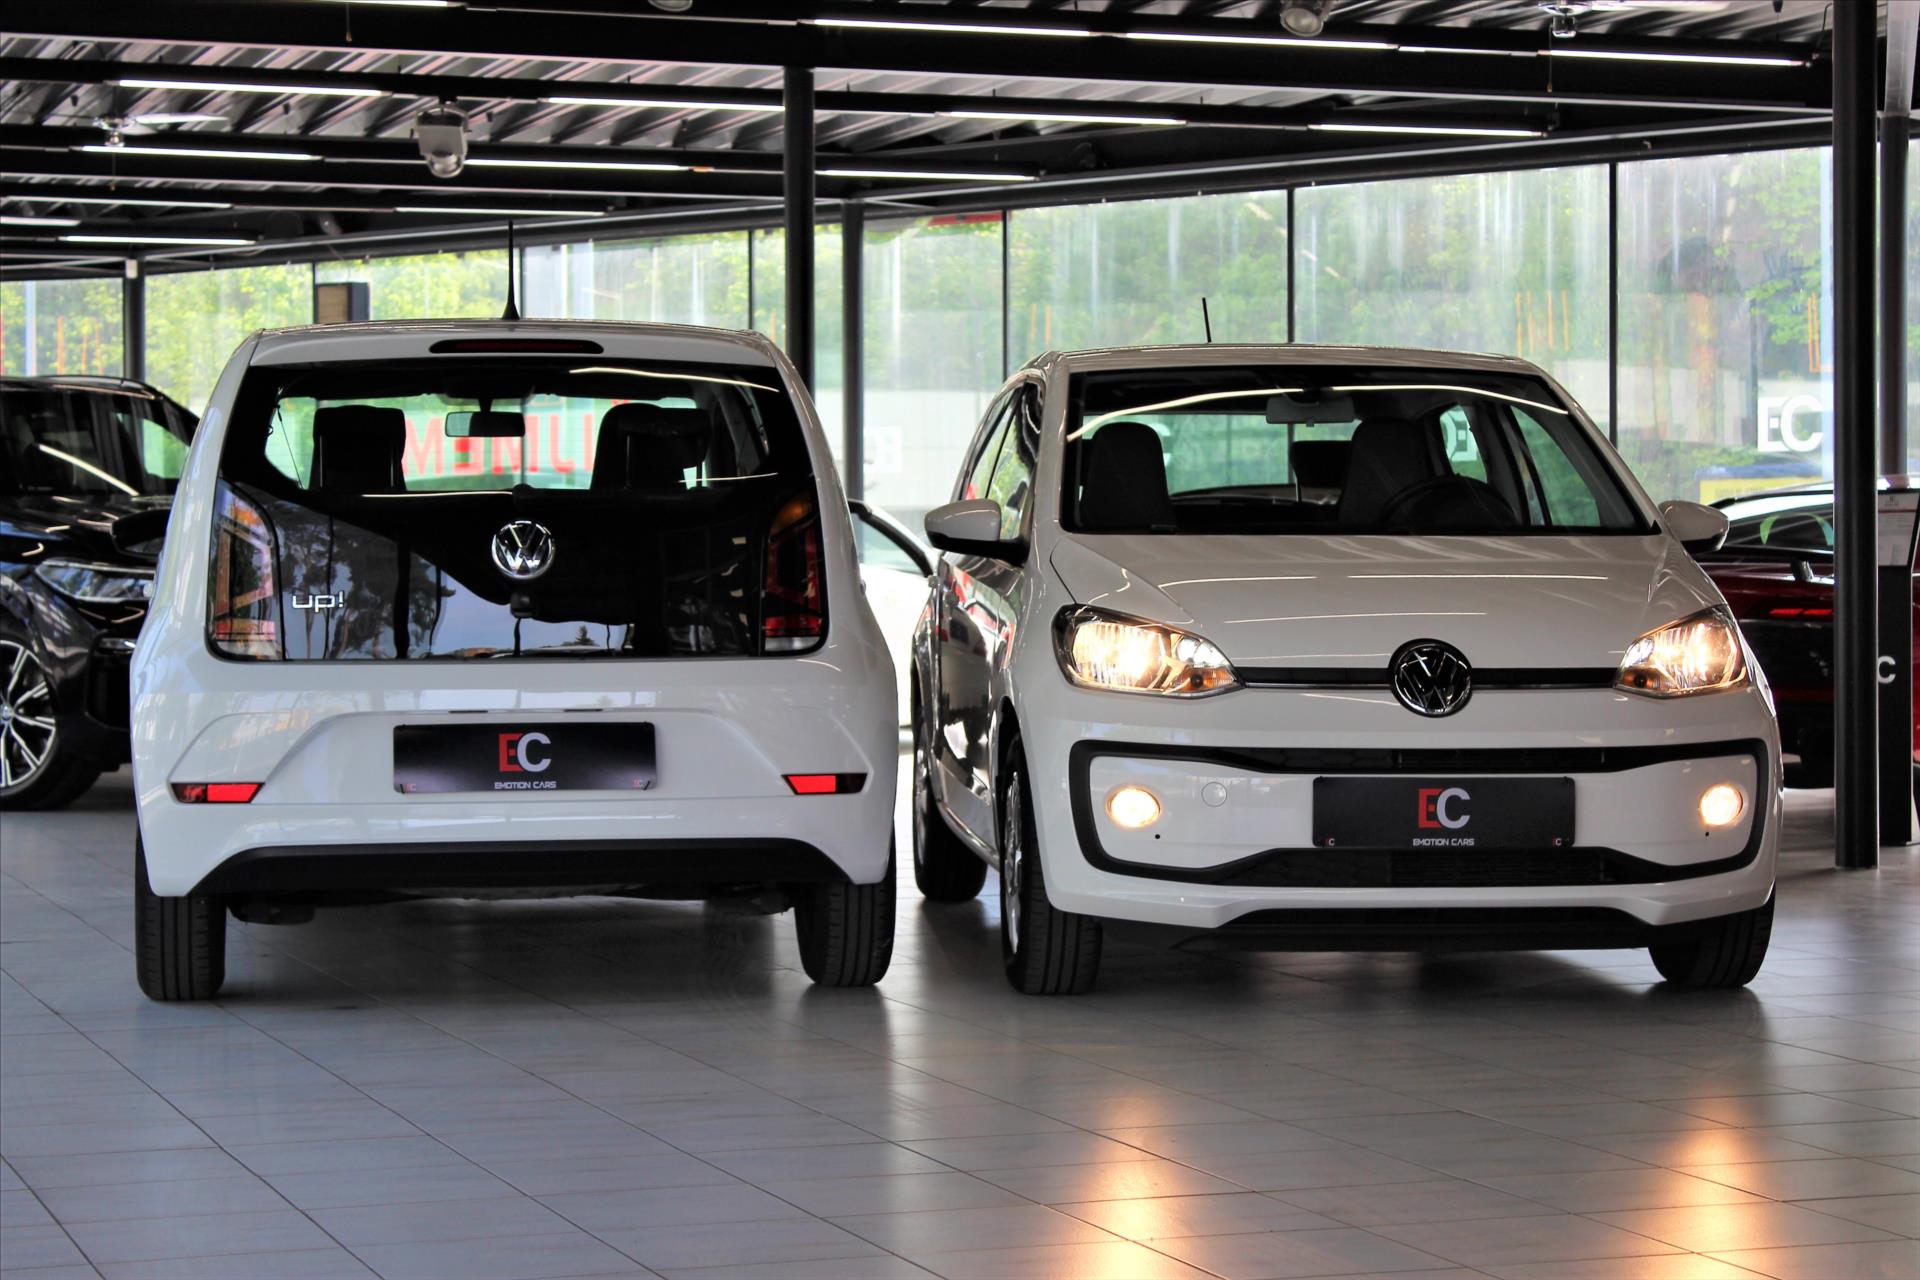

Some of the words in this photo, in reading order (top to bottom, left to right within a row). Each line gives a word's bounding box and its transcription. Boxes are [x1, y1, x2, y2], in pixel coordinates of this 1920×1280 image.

[1757, 395, 1824, 452] EC
[292, 590, 344, 613] up!
[1877, 655, 1897, 684] C
[498, 732, 552, 772] EC
[494, 781, 531, 790] EMOTION
[532, 781, 557, 789] CARS
[1418, 787, 1471, 829] EC
[1412, 838, 1449, 846] EMOTION
[1451, 838, 1475, 846] CARS
